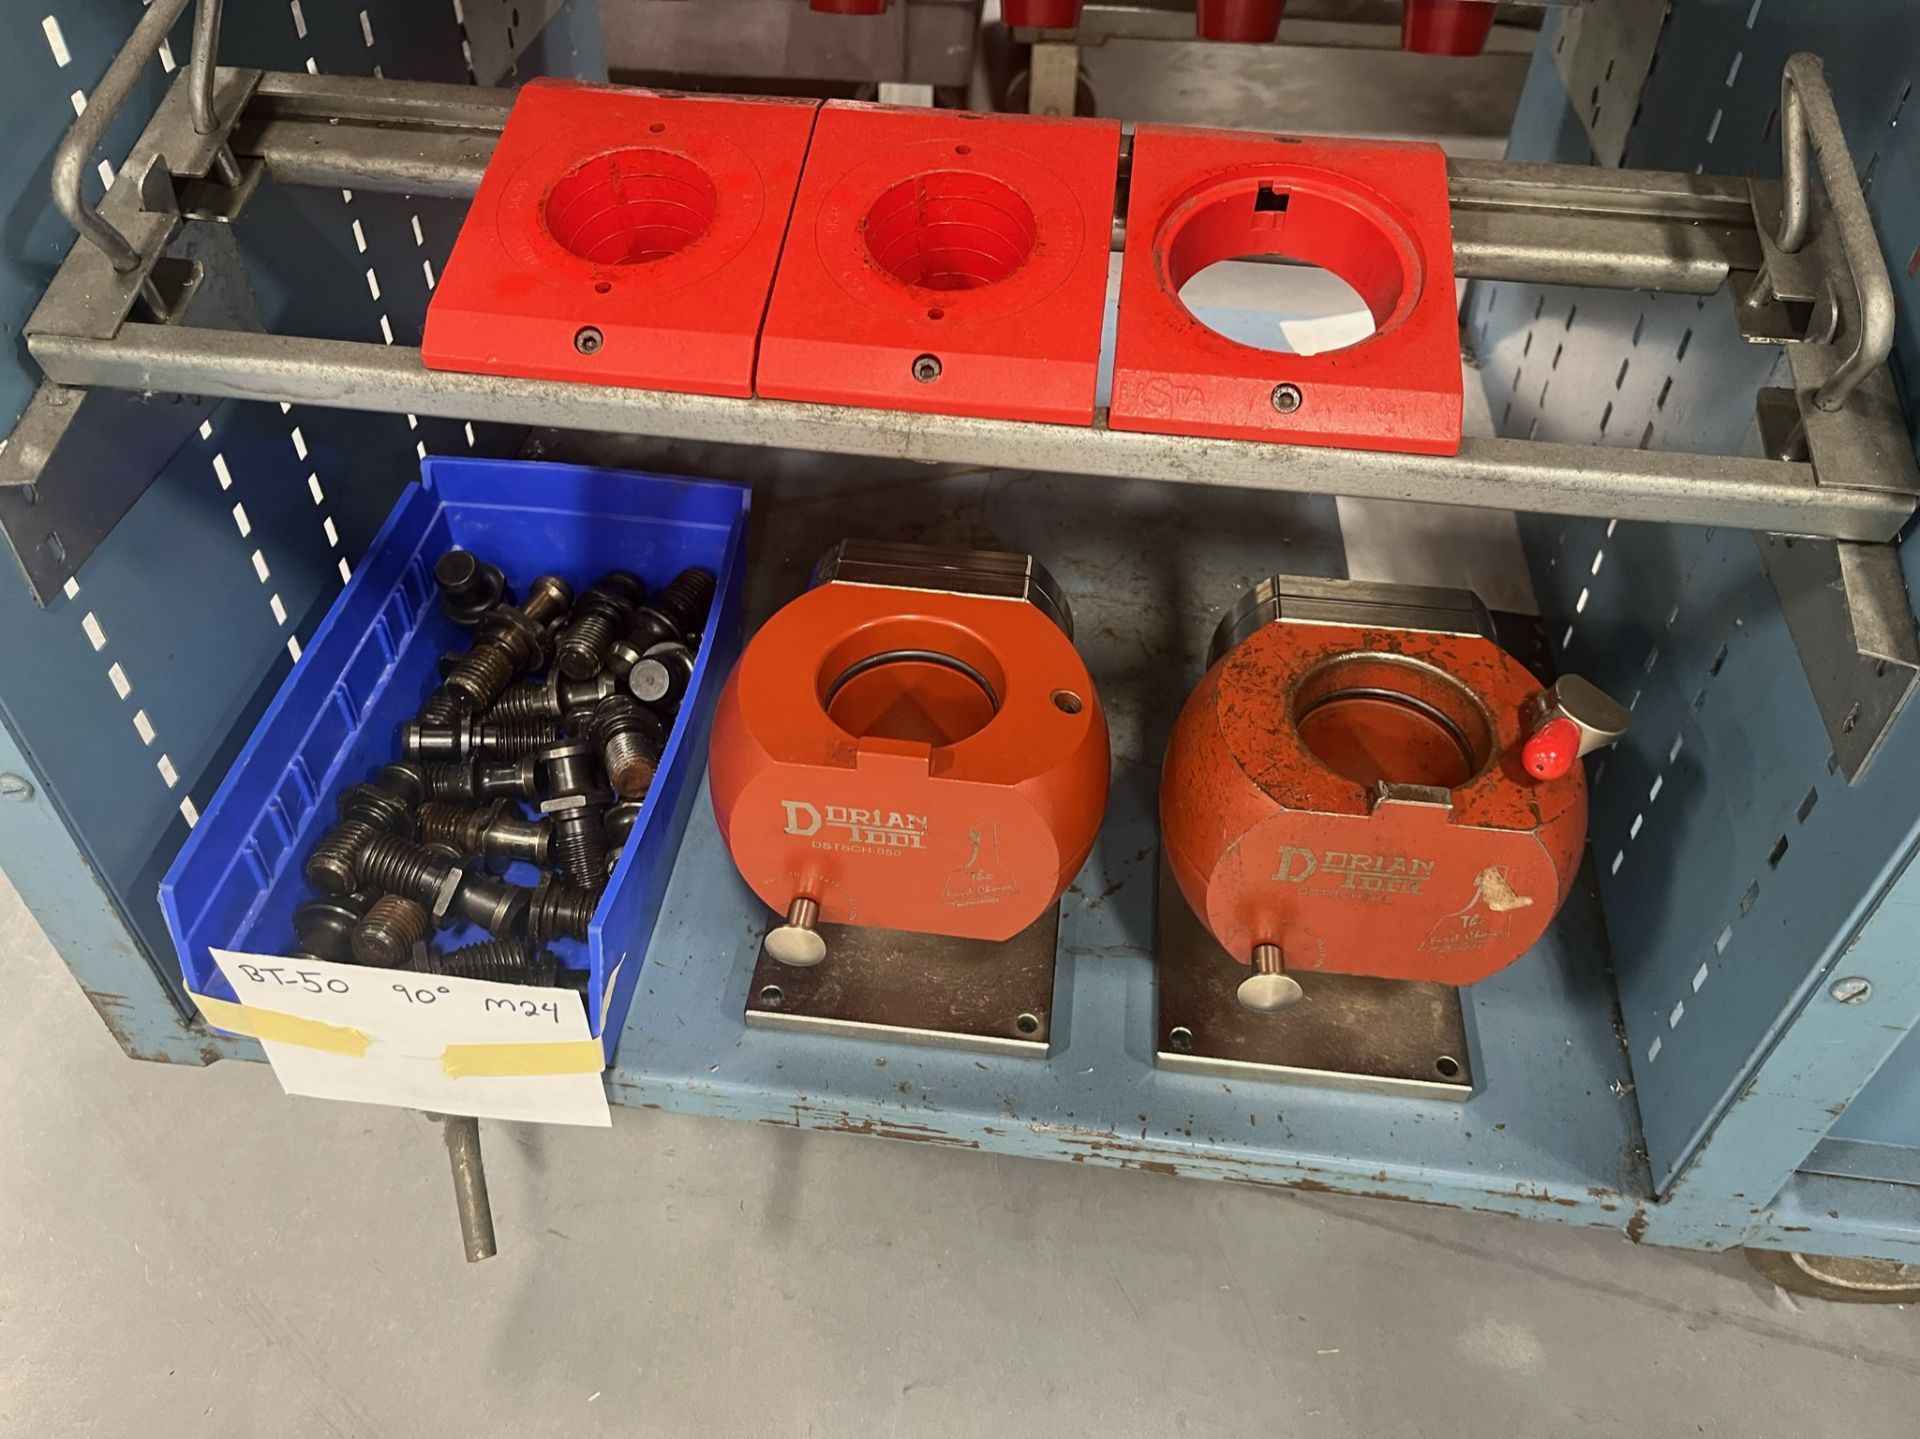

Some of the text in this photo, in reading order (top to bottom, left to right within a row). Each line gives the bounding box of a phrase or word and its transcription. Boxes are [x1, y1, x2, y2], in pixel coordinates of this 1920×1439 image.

[781, 799, 929, 837] DORIAN
[849, 818, 927, 849] TOOL
[1271, 846, 1435, 882] DORIAN
[238, 963, 350, 994] BT-50
